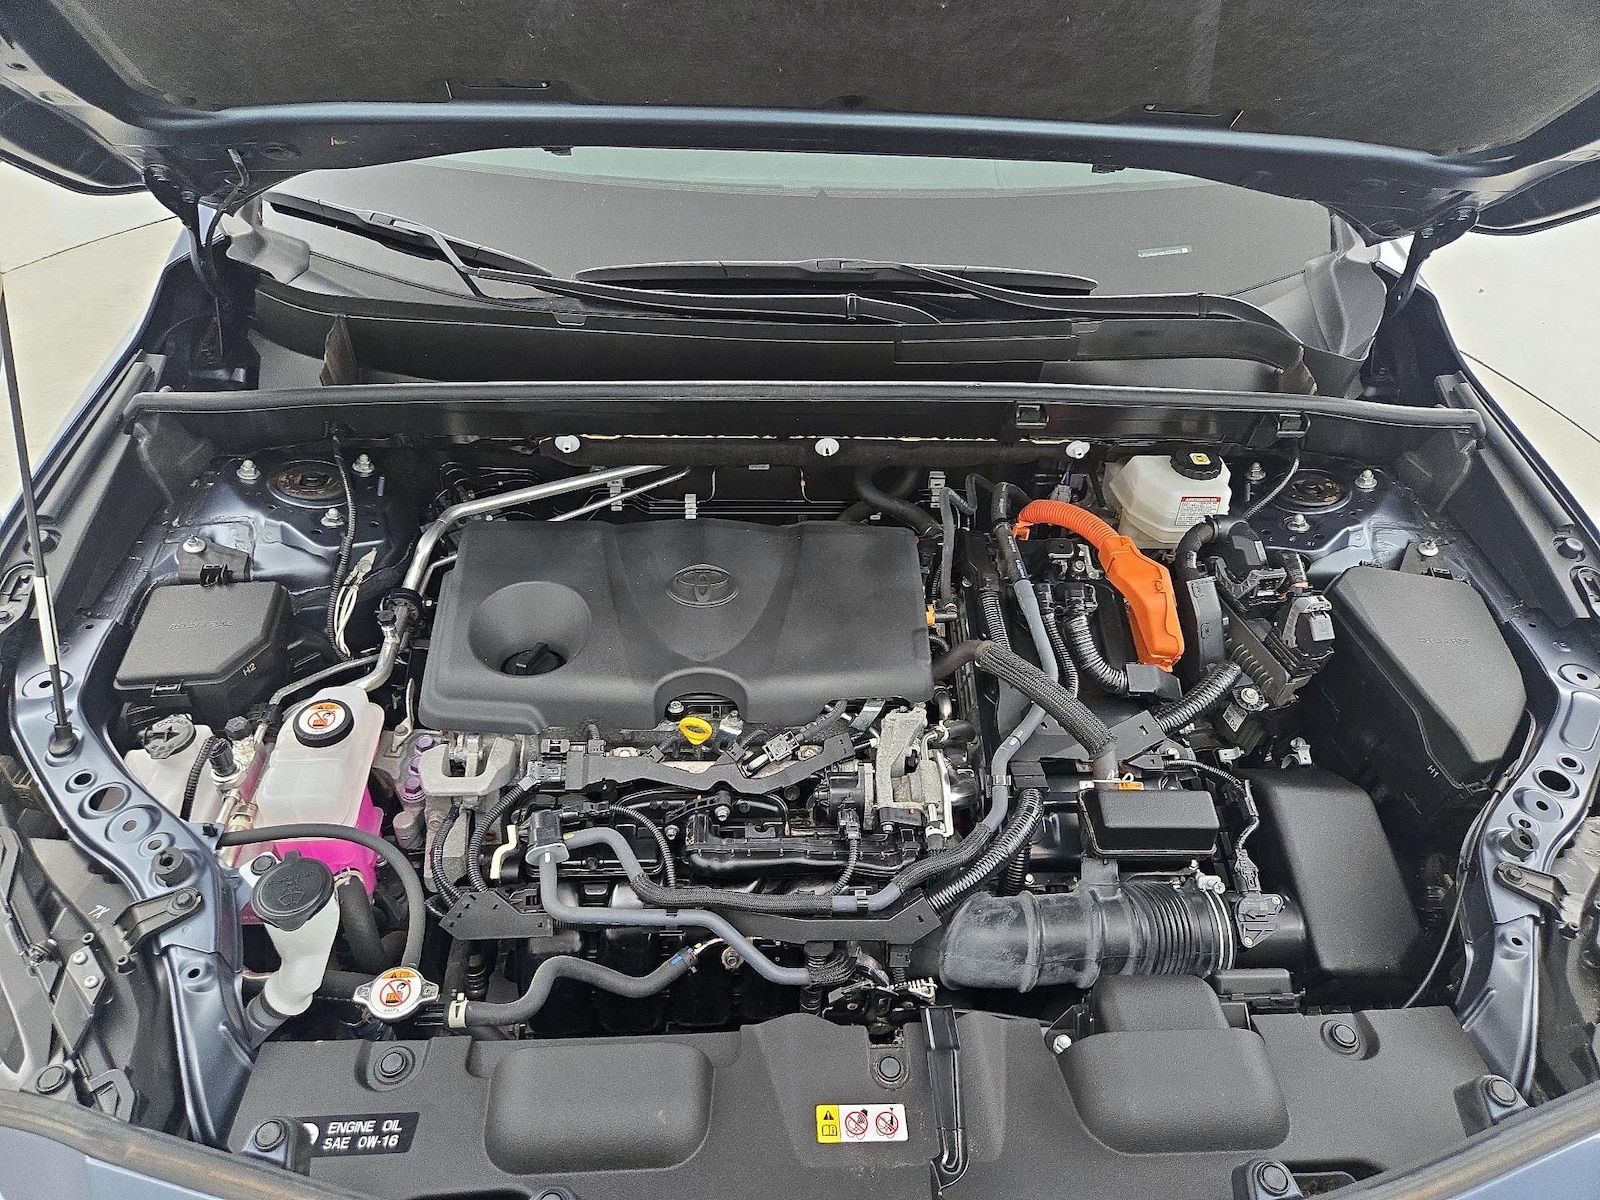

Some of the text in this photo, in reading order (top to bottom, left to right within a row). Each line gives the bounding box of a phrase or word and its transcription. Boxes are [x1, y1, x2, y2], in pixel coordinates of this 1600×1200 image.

[242, 662, 257, 677] H2
[1426, 764, 1439, 778] H1
[327, 1119, 402, 1134] ENGINE OIL
[322, 1134, 399, 1150] SAE 0W-16
